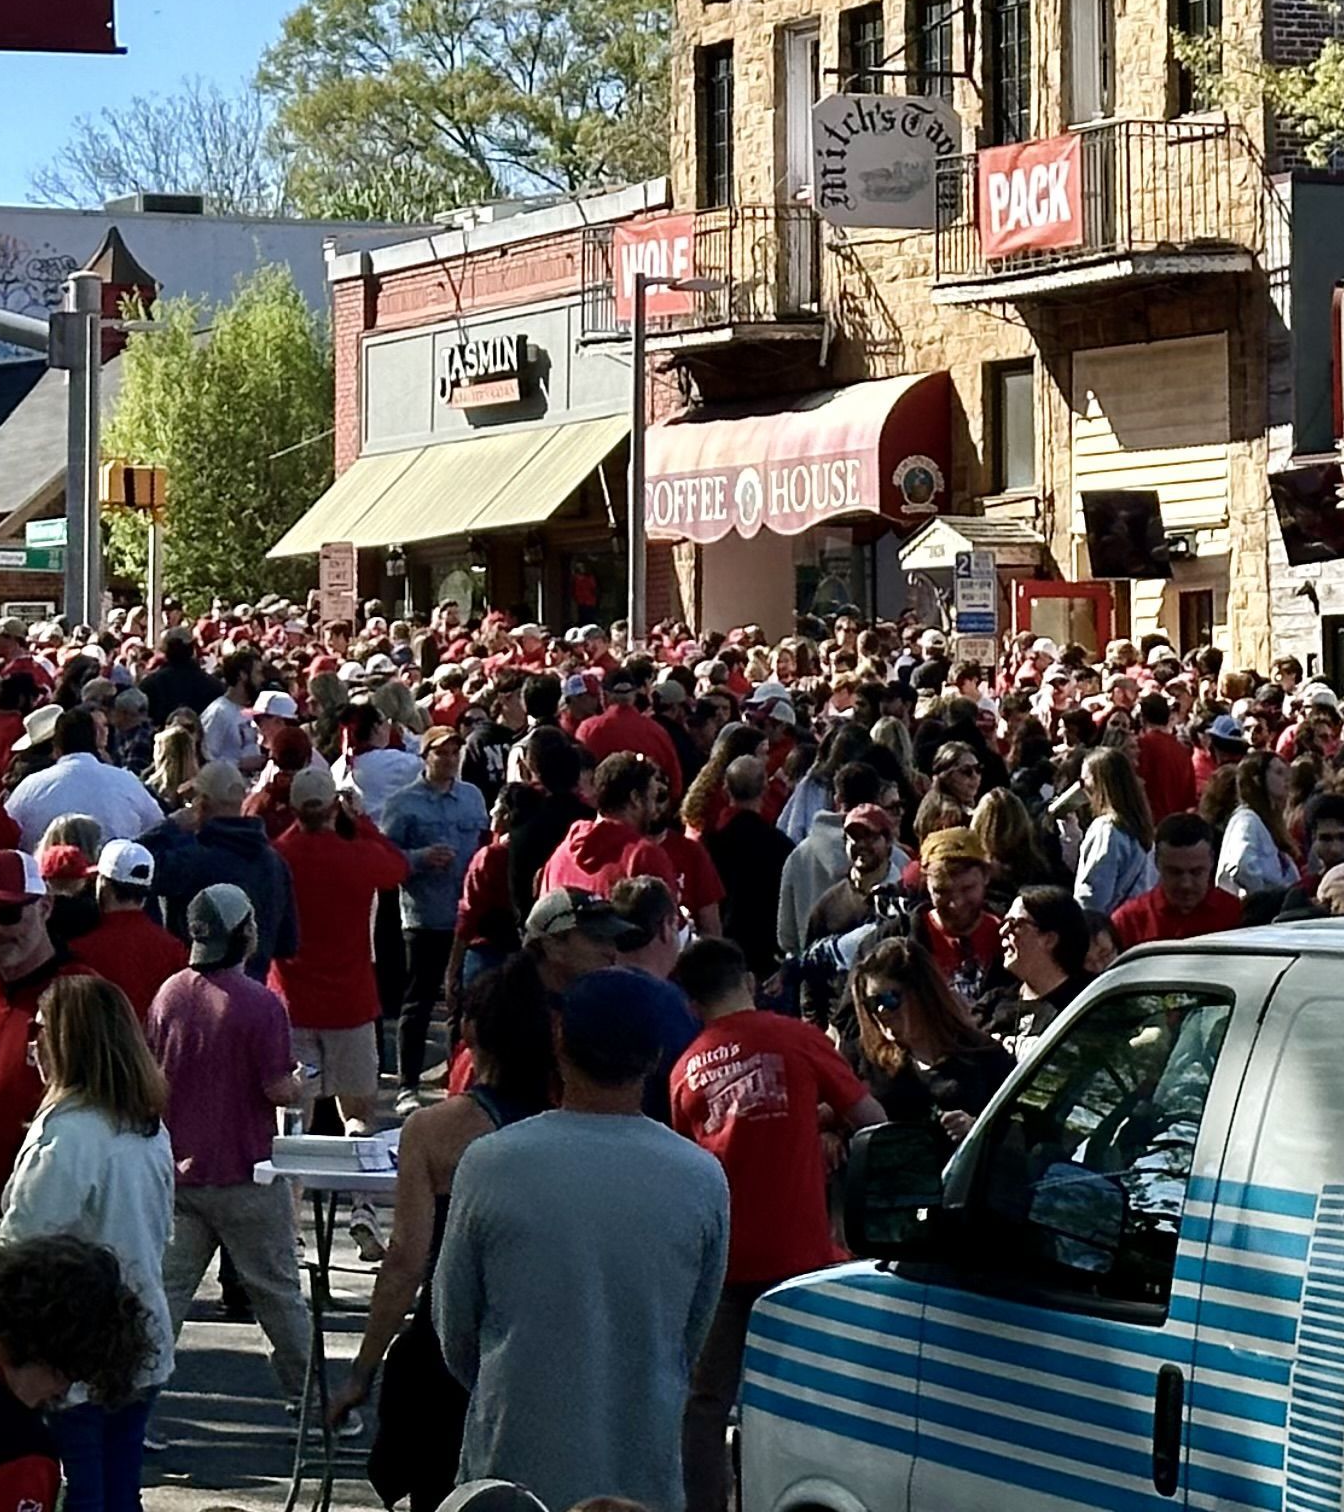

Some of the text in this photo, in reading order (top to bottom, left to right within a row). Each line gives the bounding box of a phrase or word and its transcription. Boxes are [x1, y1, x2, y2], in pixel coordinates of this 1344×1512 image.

[988, 159, 1072, 235] PACK
[621, 235, 689, 300] WOLF
[436, 334, 518, 405] JASMIN
[769, 458, 861, 516] HOUSE
[957, 555, 970, 575] 2
